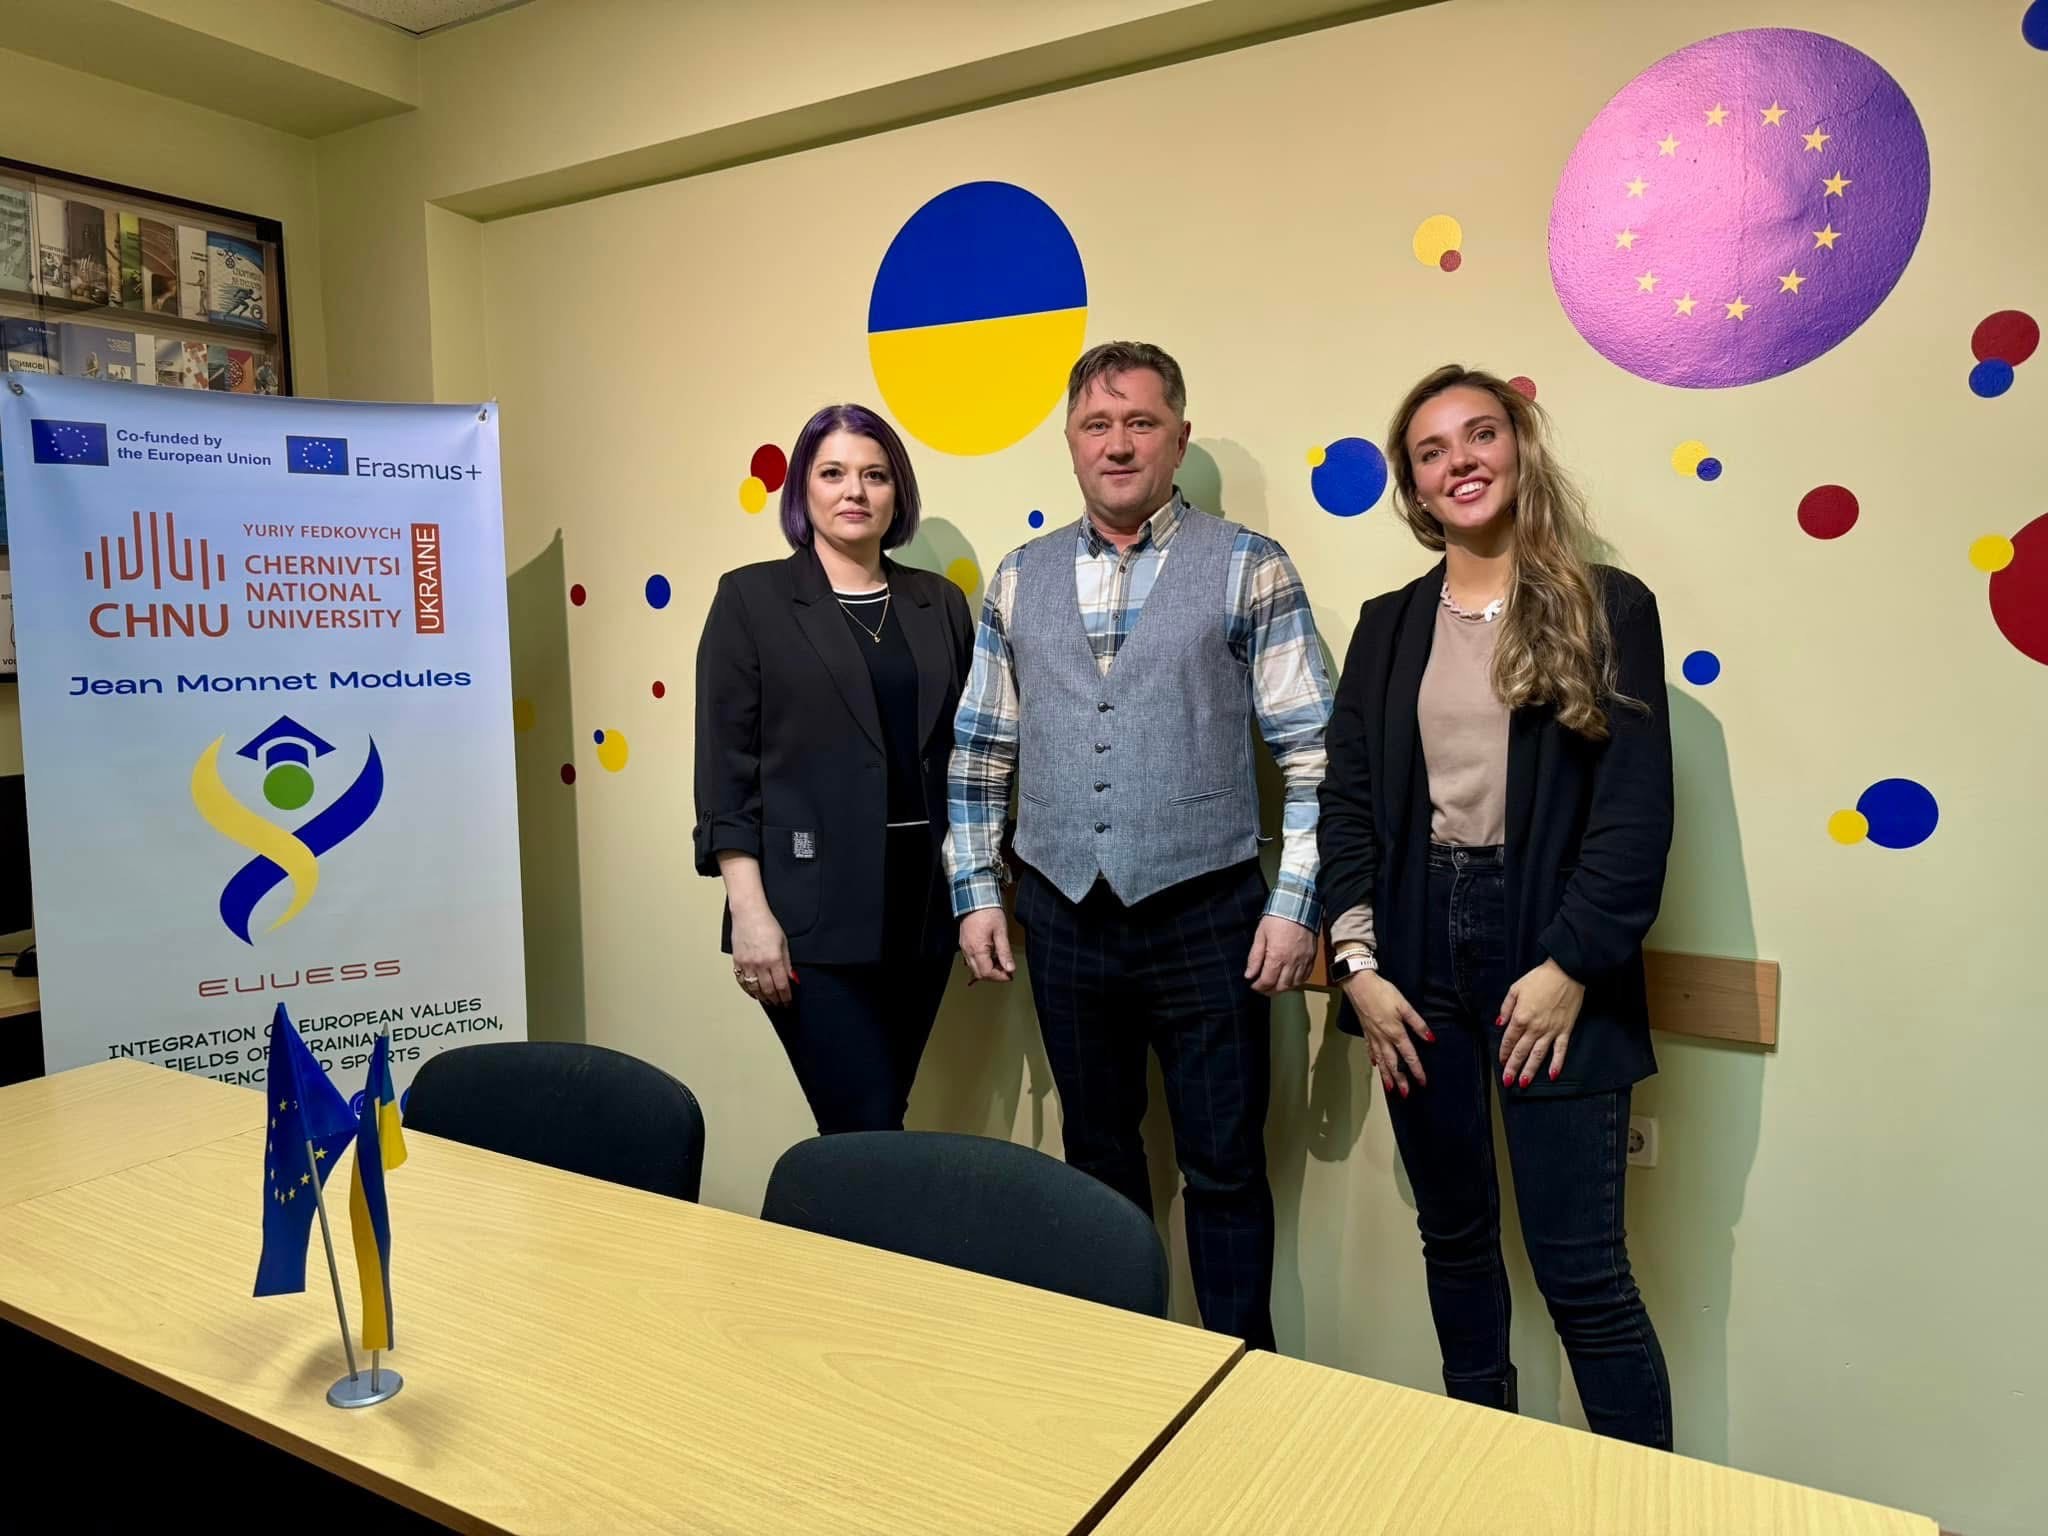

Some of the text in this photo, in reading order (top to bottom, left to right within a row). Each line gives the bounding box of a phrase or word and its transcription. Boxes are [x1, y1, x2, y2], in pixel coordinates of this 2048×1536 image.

[116, 429, 222, 450] Co-funded by
[117, 447, 272, 467] the European Union
[355, 457, 482, 481] Erasmus+
[243, 523, 401, 540] YURIY FEDKOVYCH
[244, 554, 400, 576] CHERNIVTSI
[415, 527, 440, 631] UKRAINE
[246, 582, 382, 602] NATIONAL
[89, 602, 230, 638] CHNU
[247, 608, 402, 629] UNIVERSITY
[69, 669, 472, 697] Jean Monnet Modules
[108, 1026, 256, 1060] INTEGRATION
[299, 1007, 404, 1034] EUROPEAN
[410, 998, 482, 1019] VALUES
[165, 1050, 239, 1072] FIELDS
[303, 1031, 386, 1054] RAINIA
[392, 1016, 504, 1042] EDUCATION,
[208, 1068, 266, 1085] IENC
